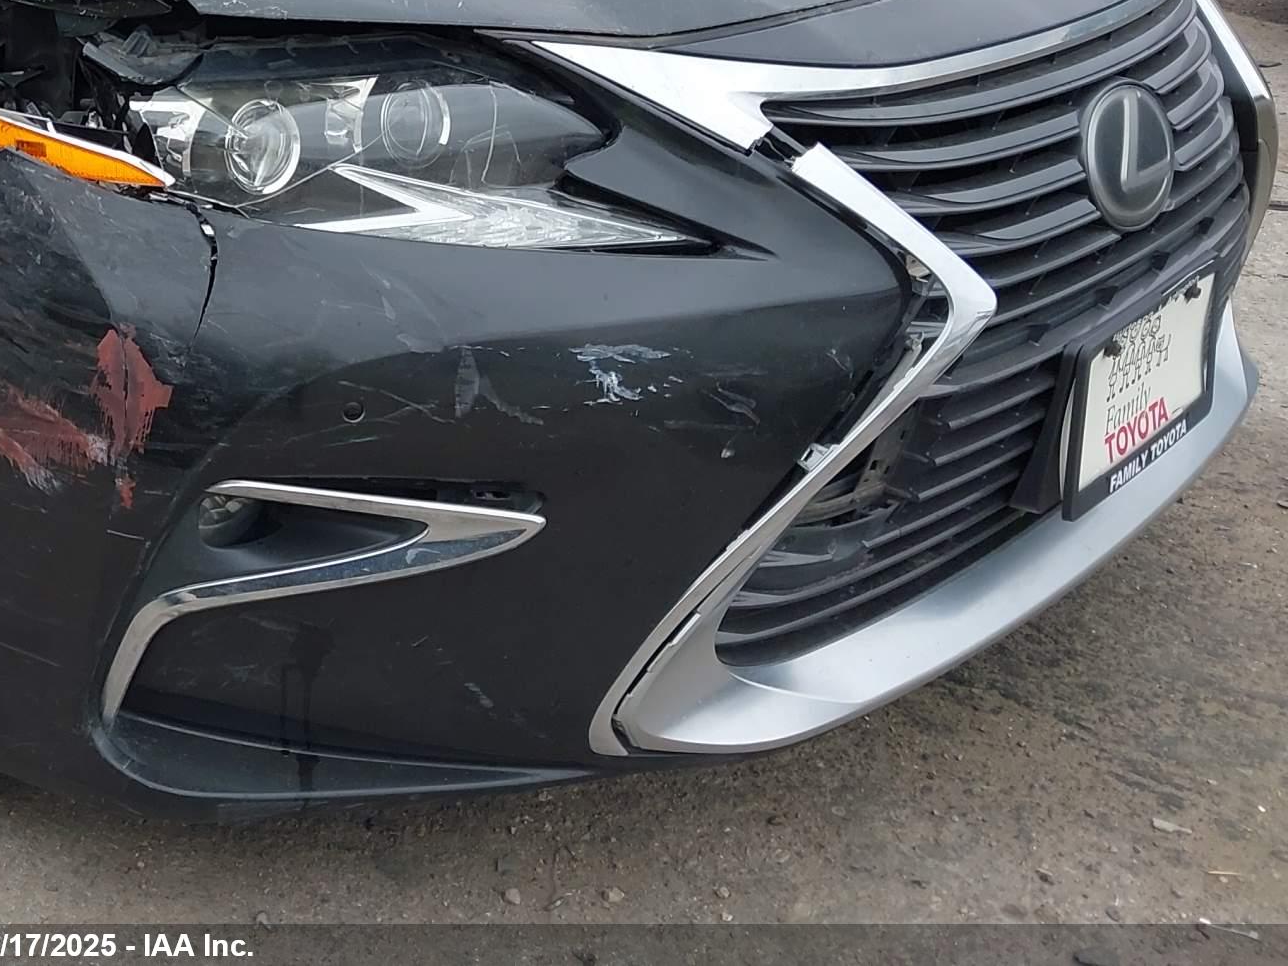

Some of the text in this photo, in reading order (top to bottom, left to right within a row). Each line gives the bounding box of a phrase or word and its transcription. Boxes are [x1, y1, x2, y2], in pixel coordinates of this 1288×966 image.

[1104, 382, 1151, 436] Family
[1104, 397, 1169, 464] TOYOTA
[1110, 418, 1187, 494] FAMILY TOYOTA
